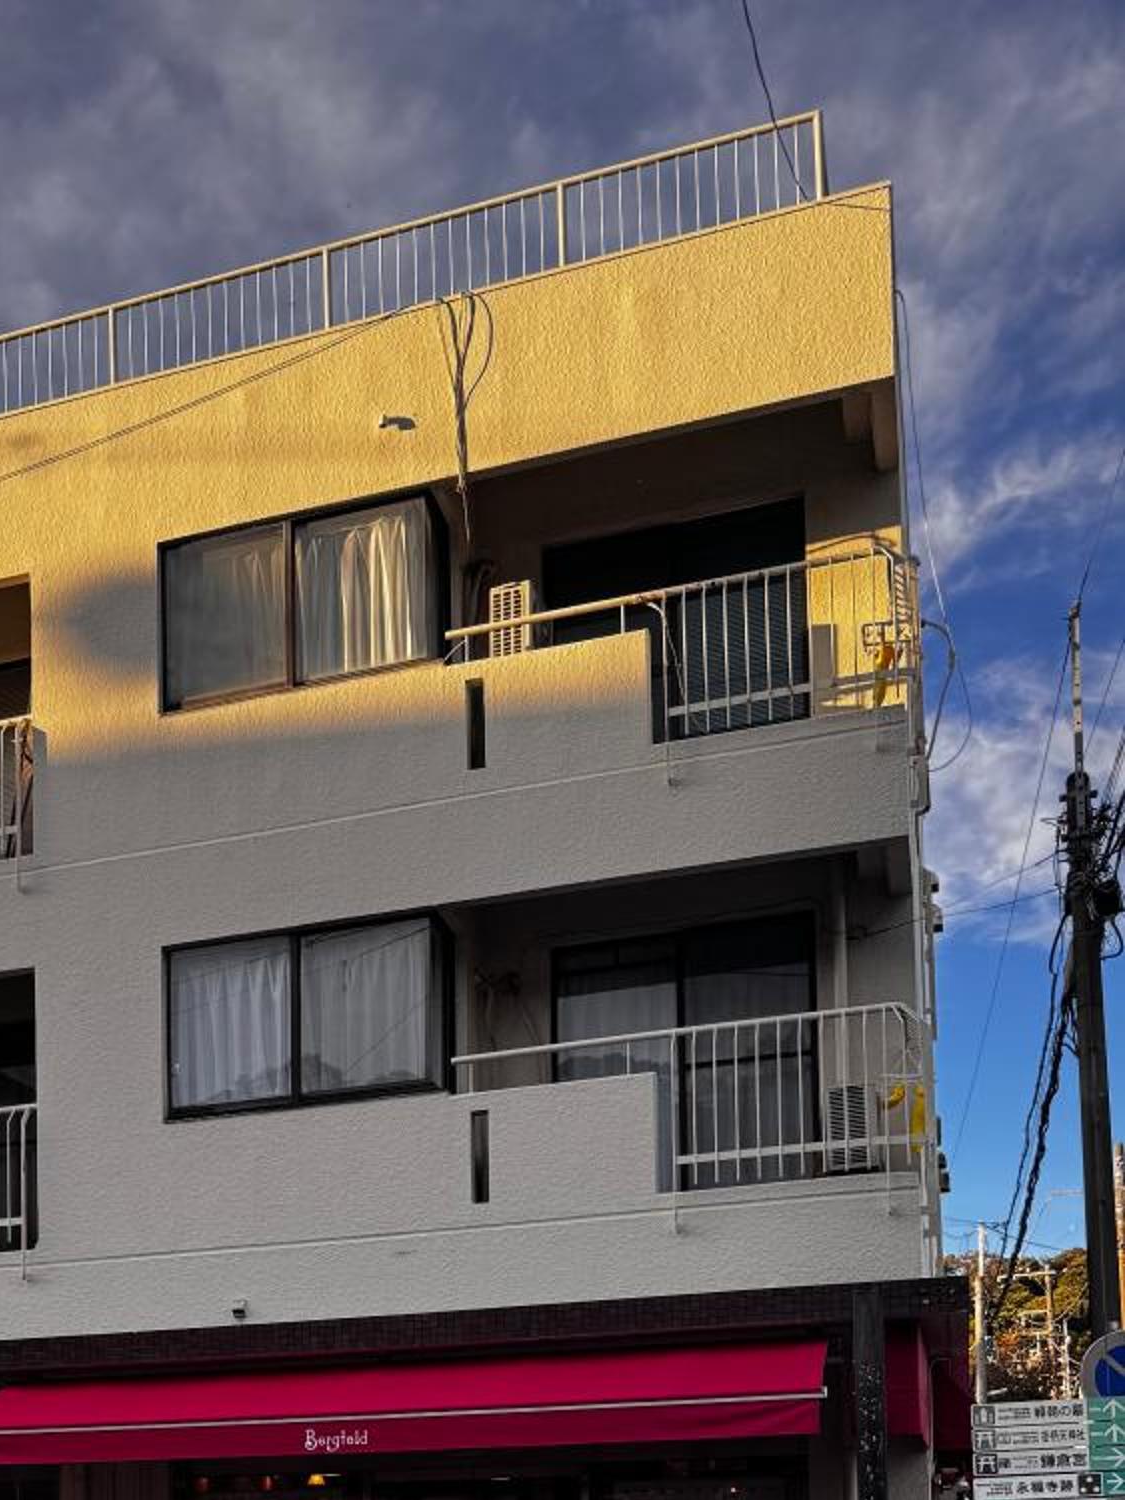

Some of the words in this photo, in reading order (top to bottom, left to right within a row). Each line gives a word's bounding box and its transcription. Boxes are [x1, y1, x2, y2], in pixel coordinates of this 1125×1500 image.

[304, 1429, 368, 1452] Bergfeld
[1040, 1452, 1087, 1469] 鎌倉宮
